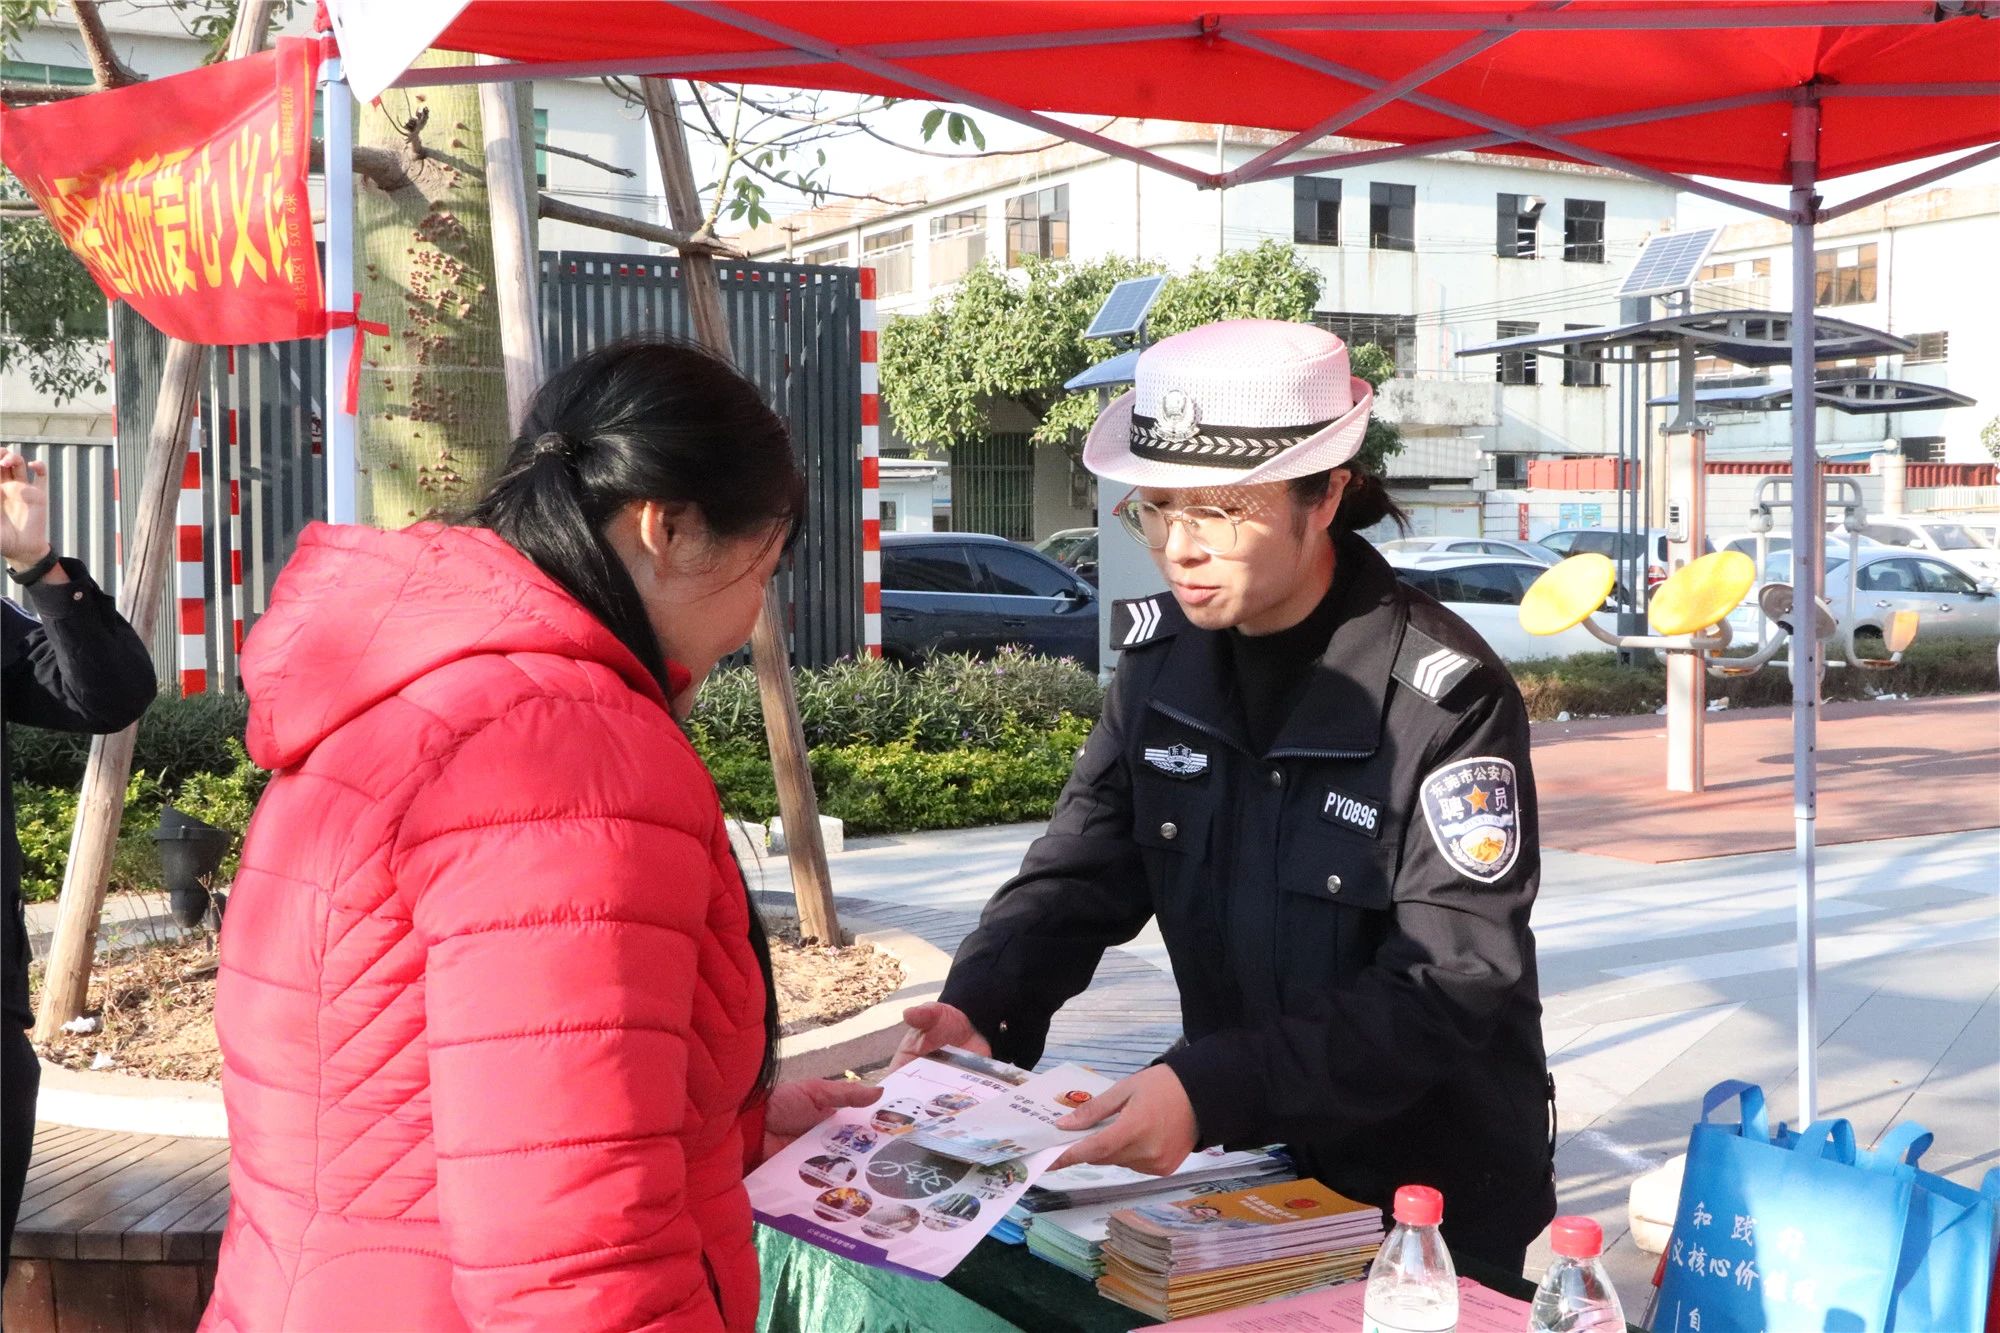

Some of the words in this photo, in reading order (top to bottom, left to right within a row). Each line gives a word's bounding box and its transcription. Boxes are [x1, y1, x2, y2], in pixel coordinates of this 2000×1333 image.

[1429, 765, 1512, 798] 东莞市公安局
[1324, 791, 1378, 830] PY0896
[1494, 787, 1509, 811] 员
